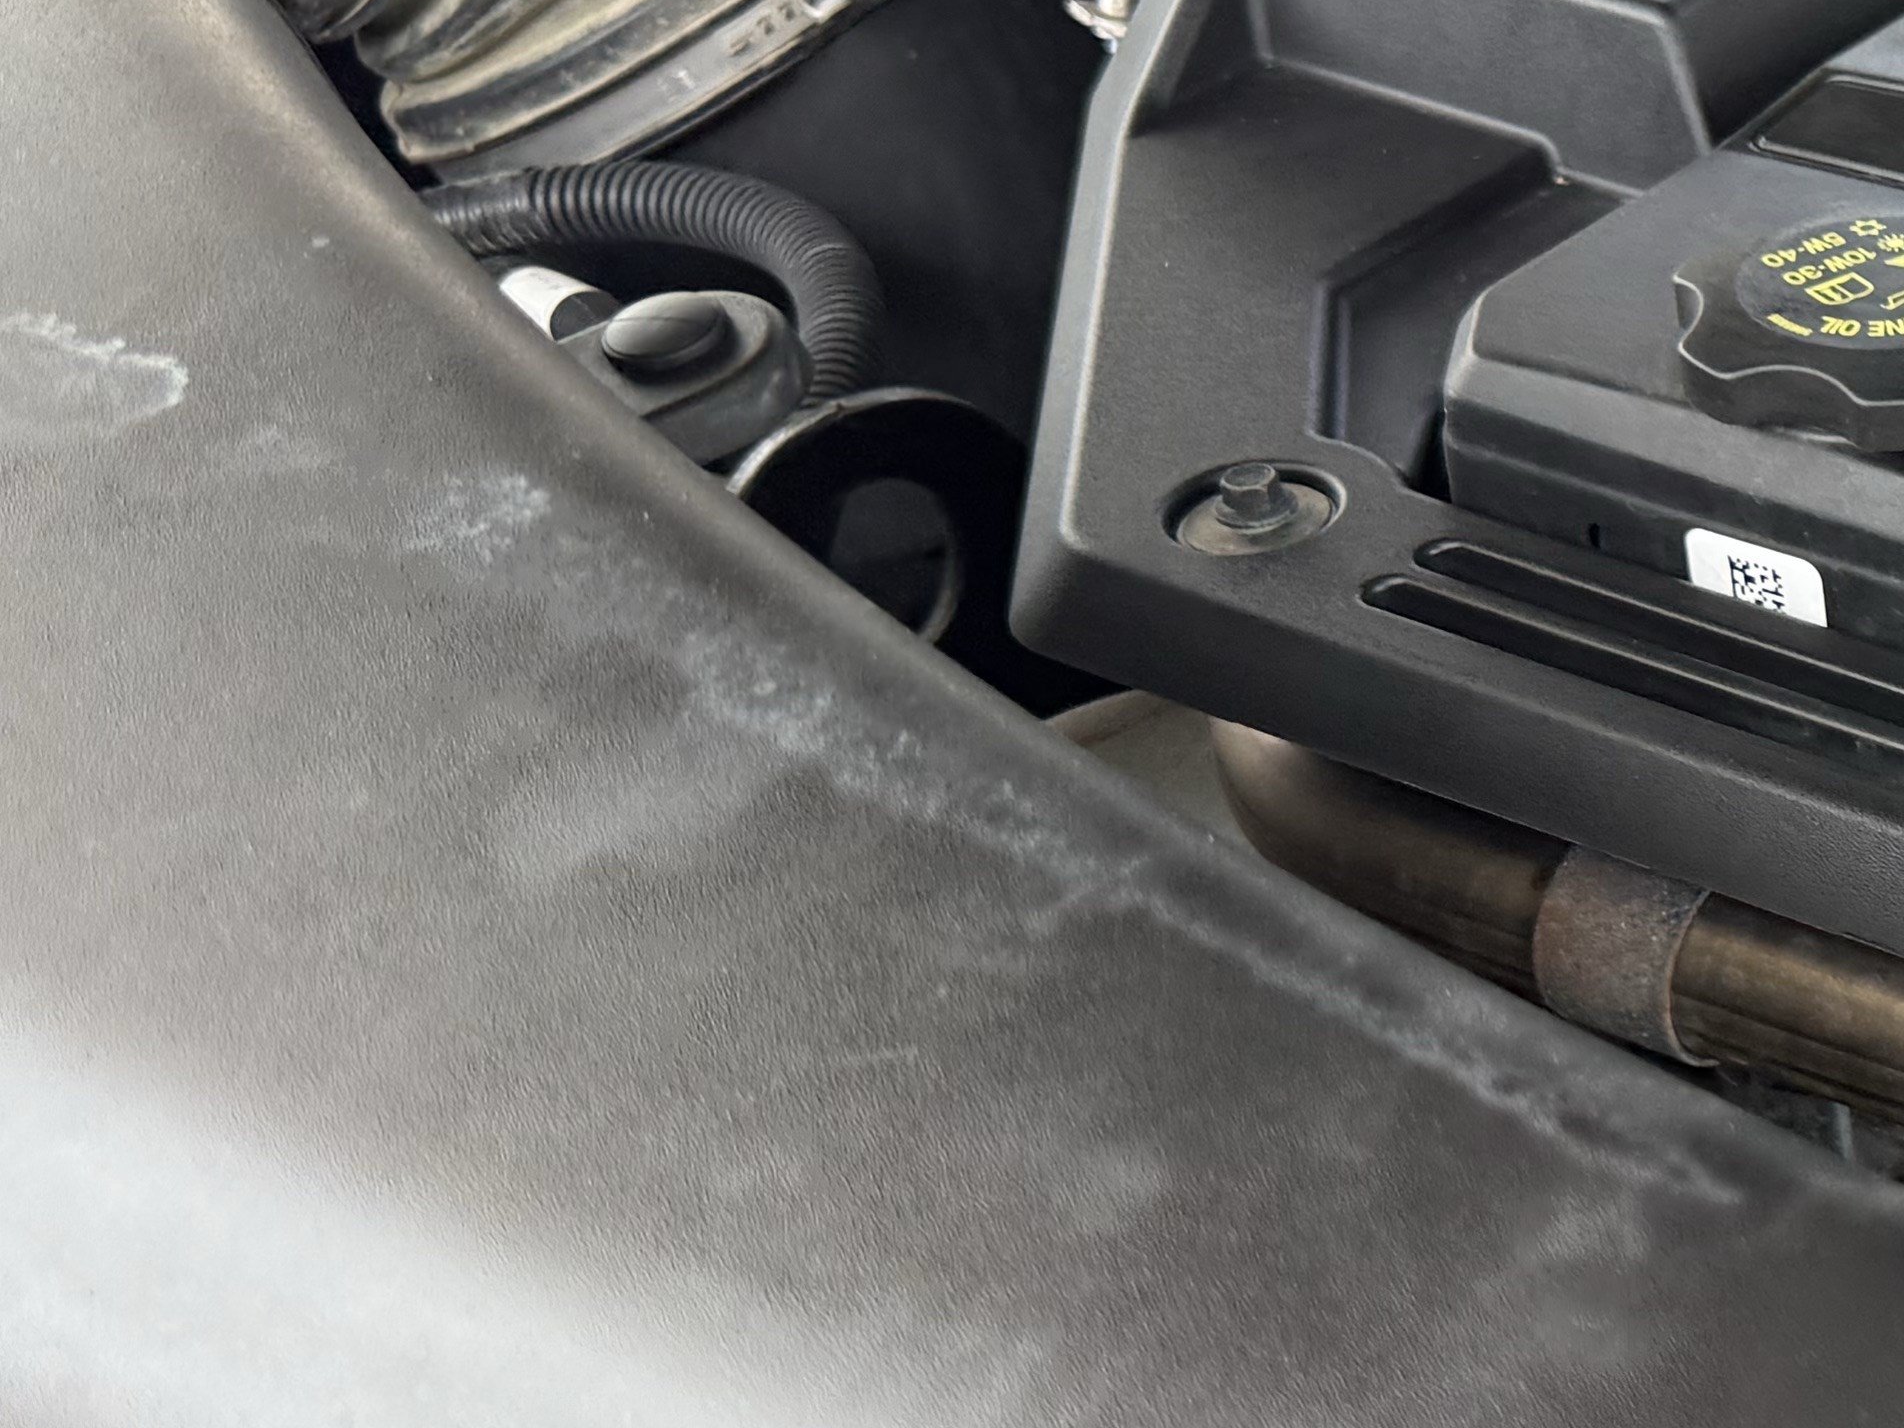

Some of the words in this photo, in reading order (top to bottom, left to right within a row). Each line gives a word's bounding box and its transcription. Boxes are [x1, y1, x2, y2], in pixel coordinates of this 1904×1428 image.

[1760, 231, 1847, 269] 5W-40
[1782, 247, 1877, 286] 10W-30
[1820, 315, 1861, 337] OIL
